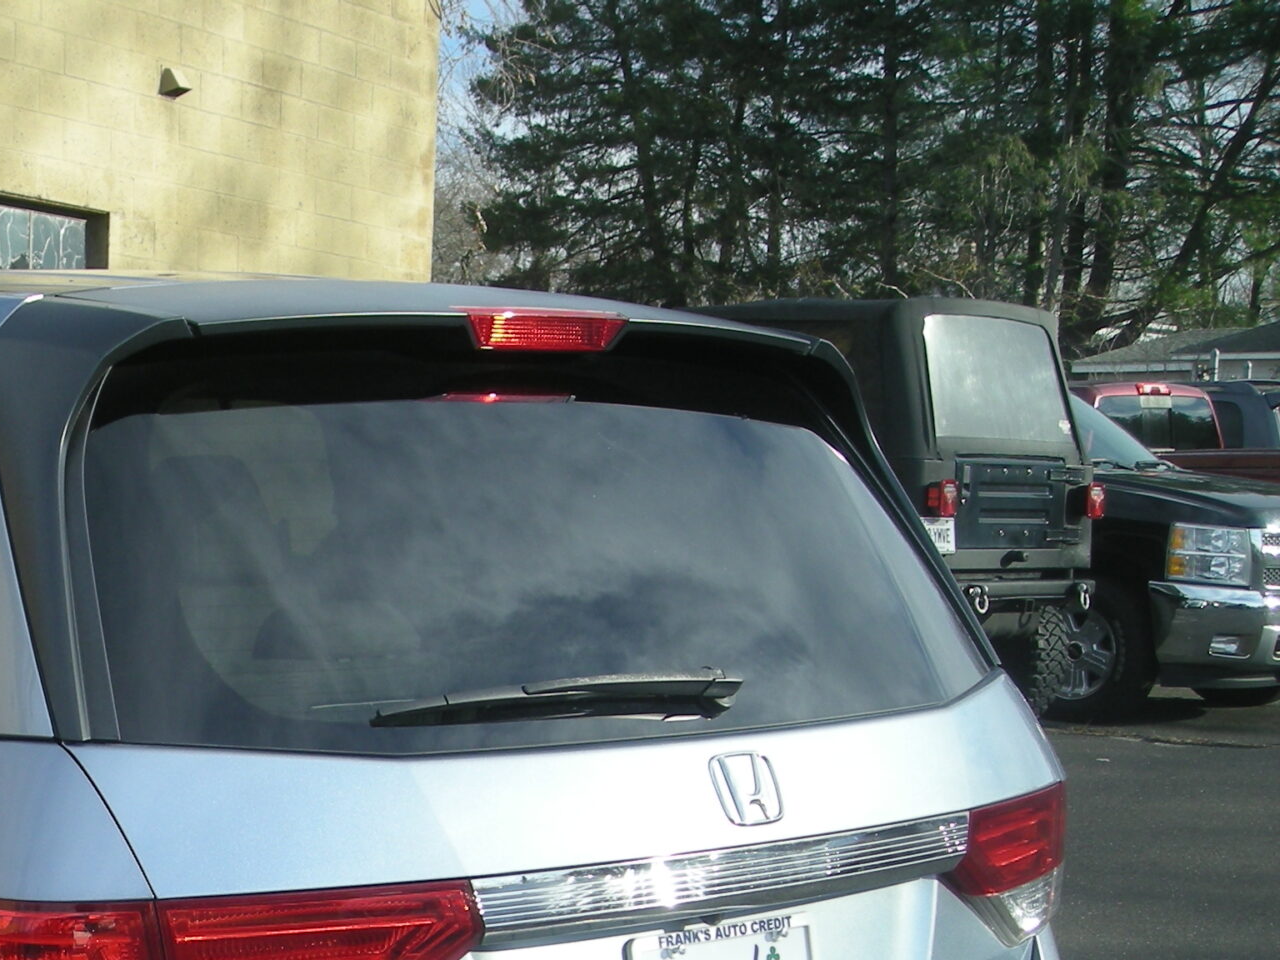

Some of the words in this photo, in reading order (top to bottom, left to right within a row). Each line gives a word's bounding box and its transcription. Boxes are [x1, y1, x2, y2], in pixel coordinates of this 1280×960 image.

[658, 928, 712, 949] FRANK'S
[714, 922, 748, 941] AUTO
[750, 915, 793, 934] CREDIT
